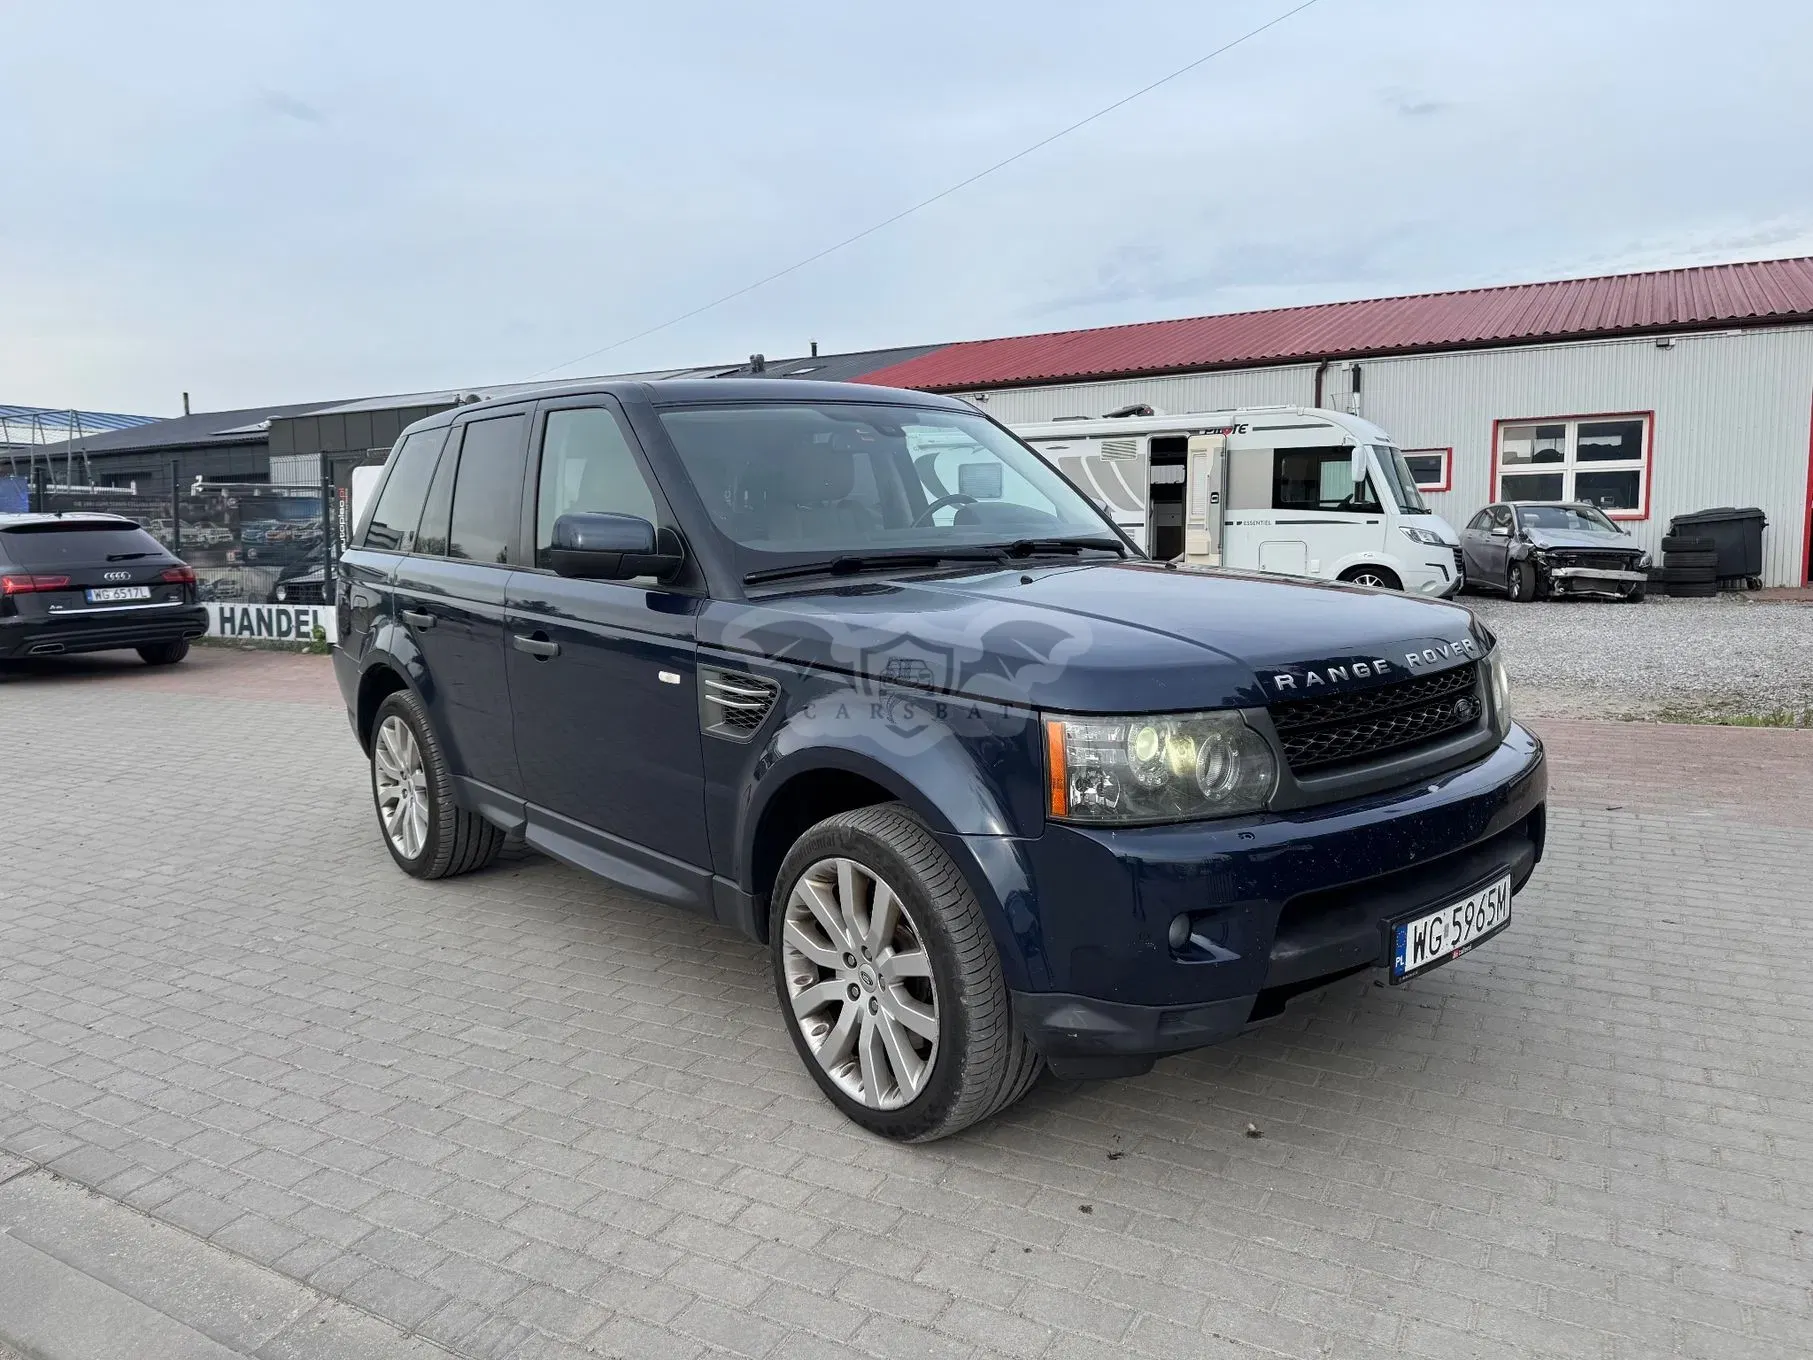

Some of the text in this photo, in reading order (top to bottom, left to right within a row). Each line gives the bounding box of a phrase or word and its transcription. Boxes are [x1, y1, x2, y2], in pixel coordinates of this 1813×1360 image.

[94, 586, 148, 600] WG 6517L
[1274, 638, 1474, 691] RANGE ROVER
[1413, 881, 1507, 964] WG 5965M
[1395, 956, 1405, 967] PL
